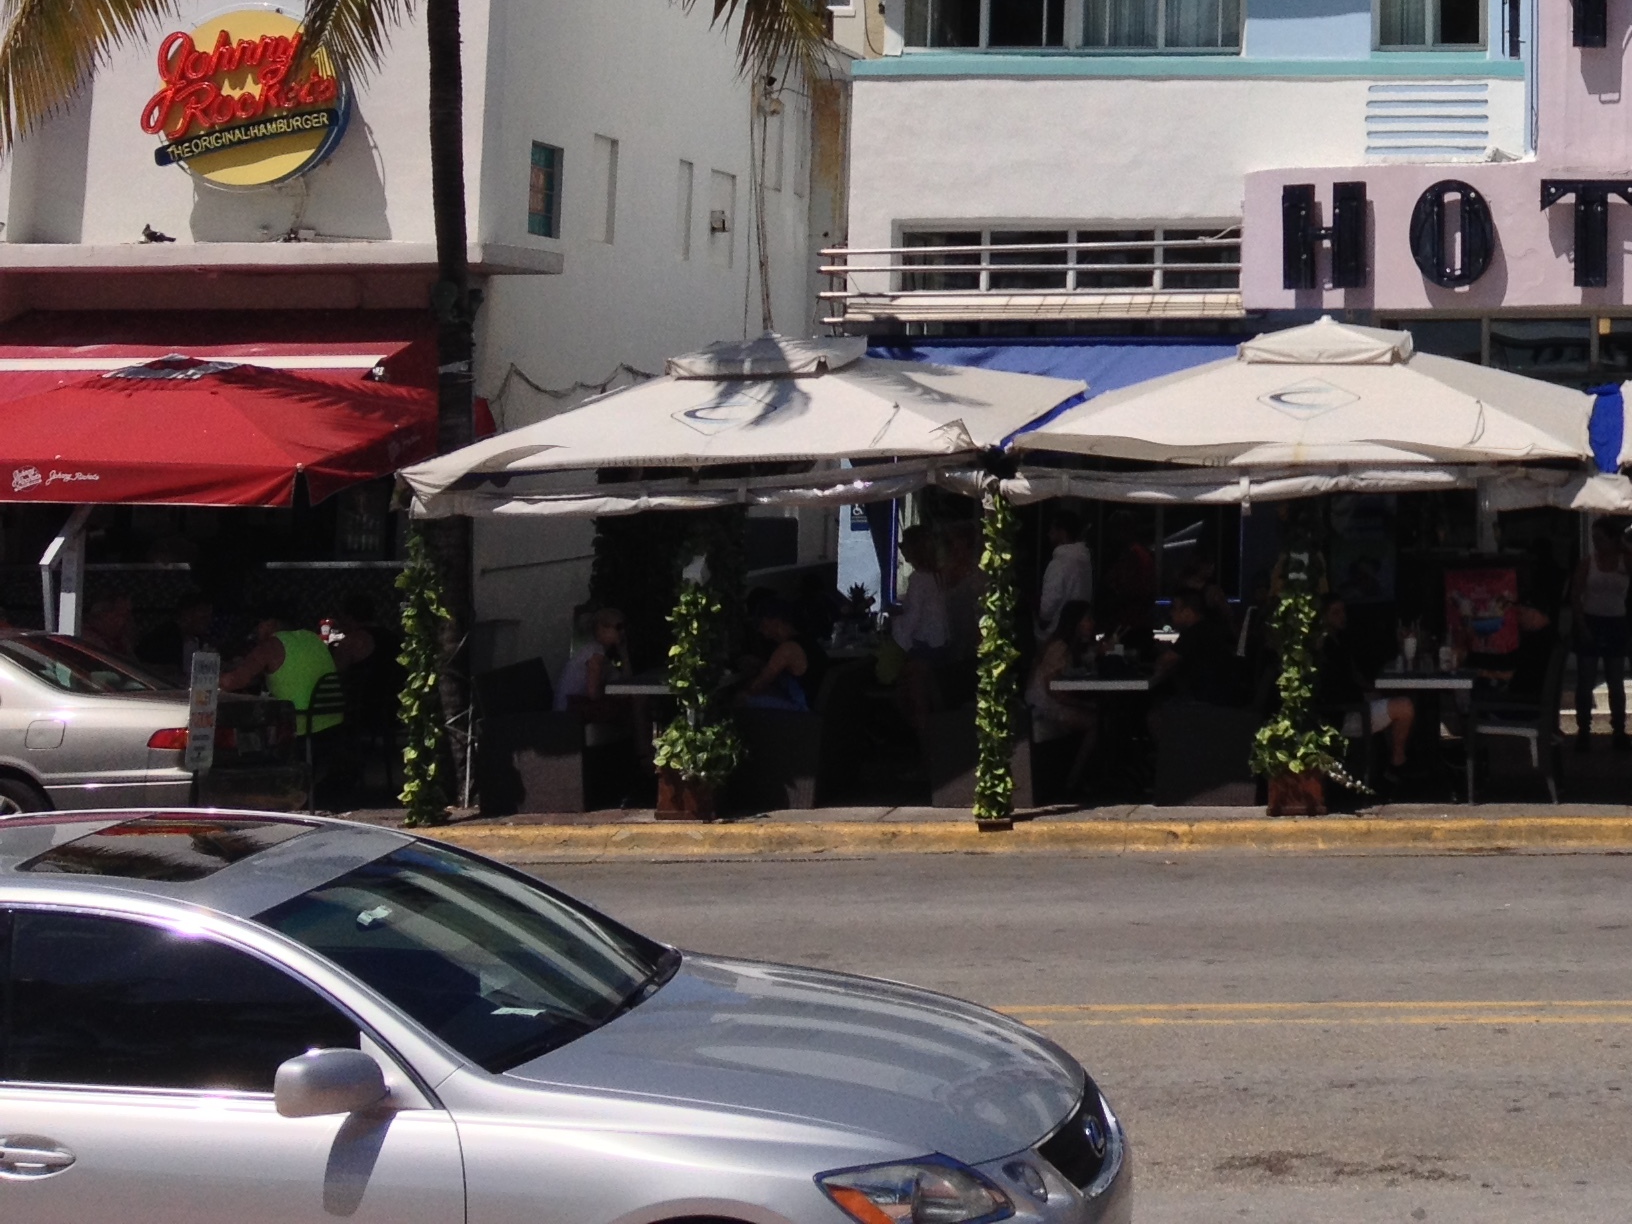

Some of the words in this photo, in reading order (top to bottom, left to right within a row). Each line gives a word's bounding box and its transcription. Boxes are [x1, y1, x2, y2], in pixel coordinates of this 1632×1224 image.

[140, 30, 303, 134] Johnny
[166, 68, 337, 139] Rockets
[167, 142, 192, 161] THE
[191, 126, 249, 153] ORIGINAL
[250, 112, 329, 137] HAMBURGER
